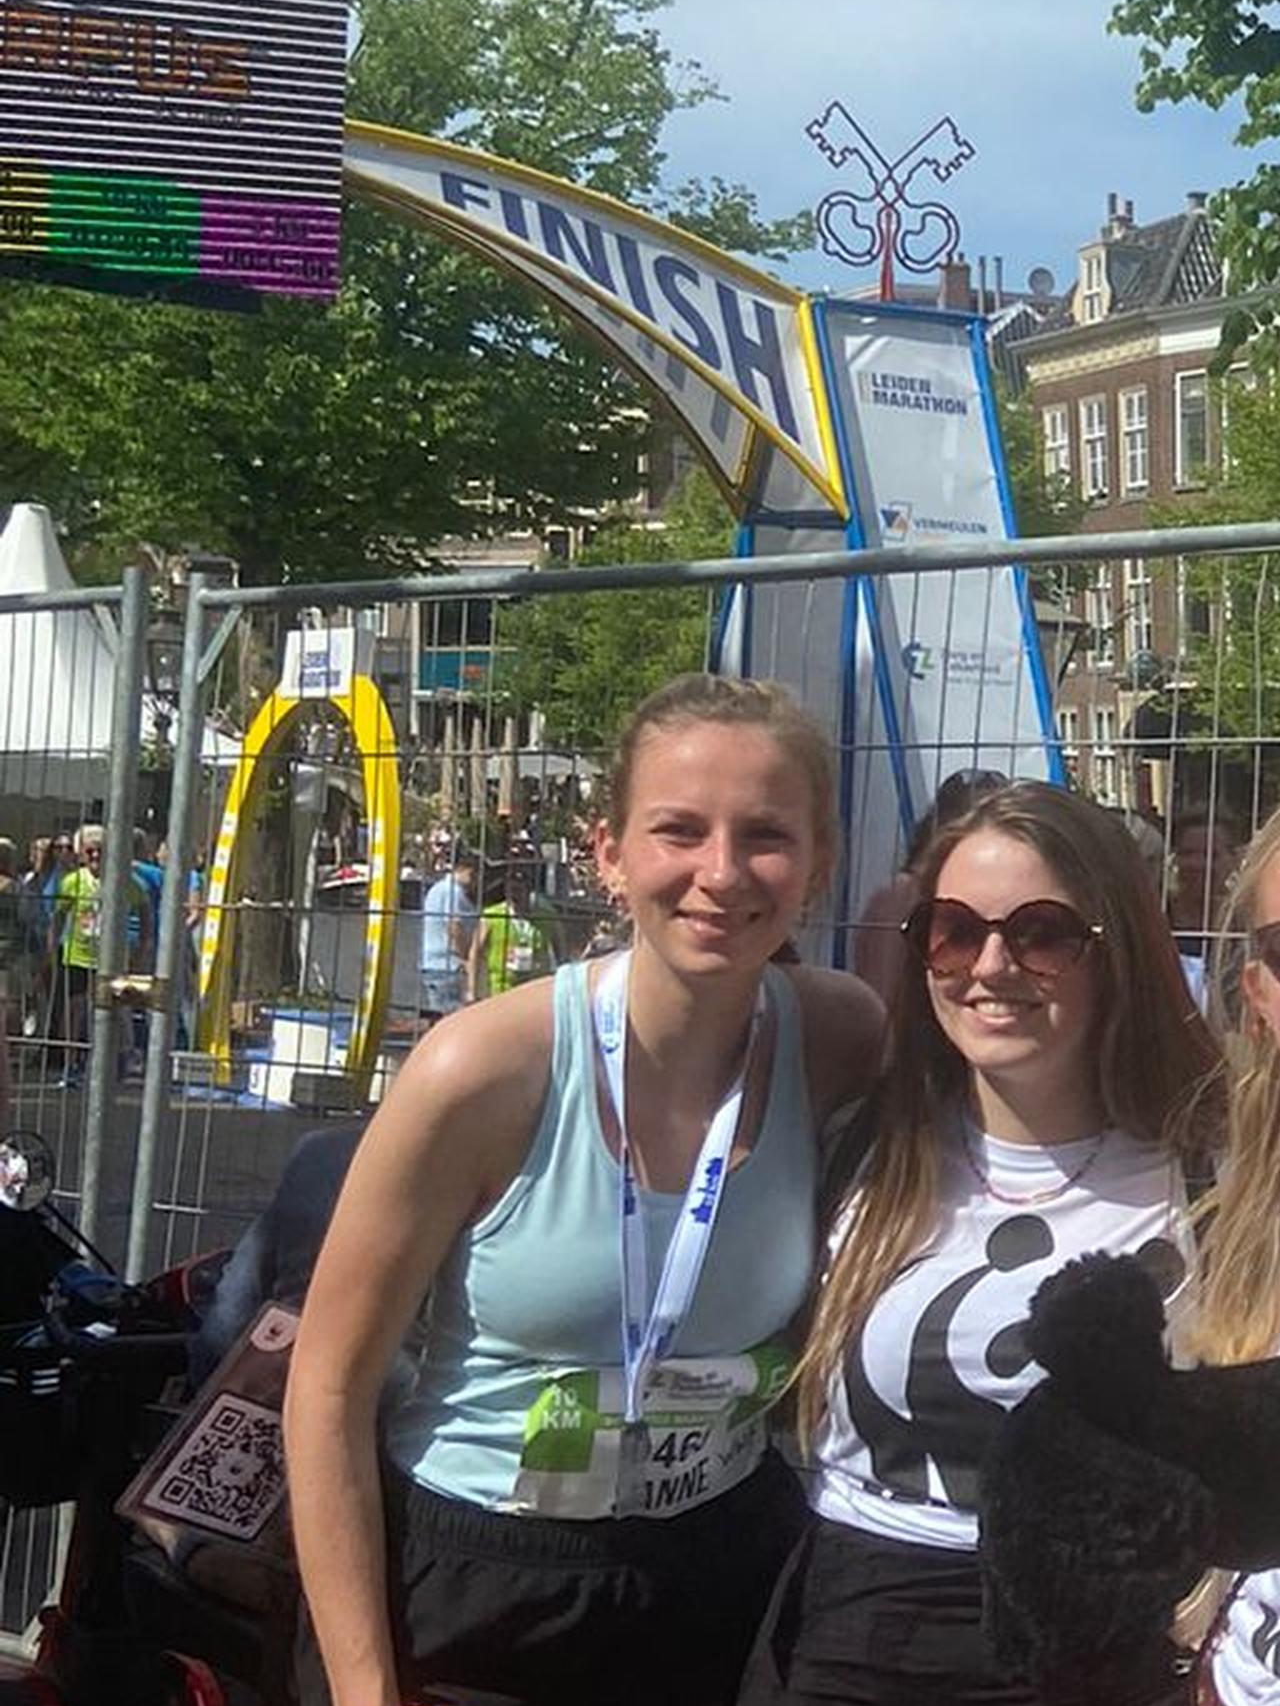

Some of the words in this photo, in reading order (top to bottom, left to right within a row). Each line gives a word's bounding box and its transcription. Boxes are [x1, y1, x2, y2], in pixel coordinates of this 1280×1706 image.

[439, 171, 801, 445] FINISH
[872, 373, 931, 394] LEIDEN
[872, 390, 968, 415] MARATHON
[541, 1409, 582, 1429] KM
